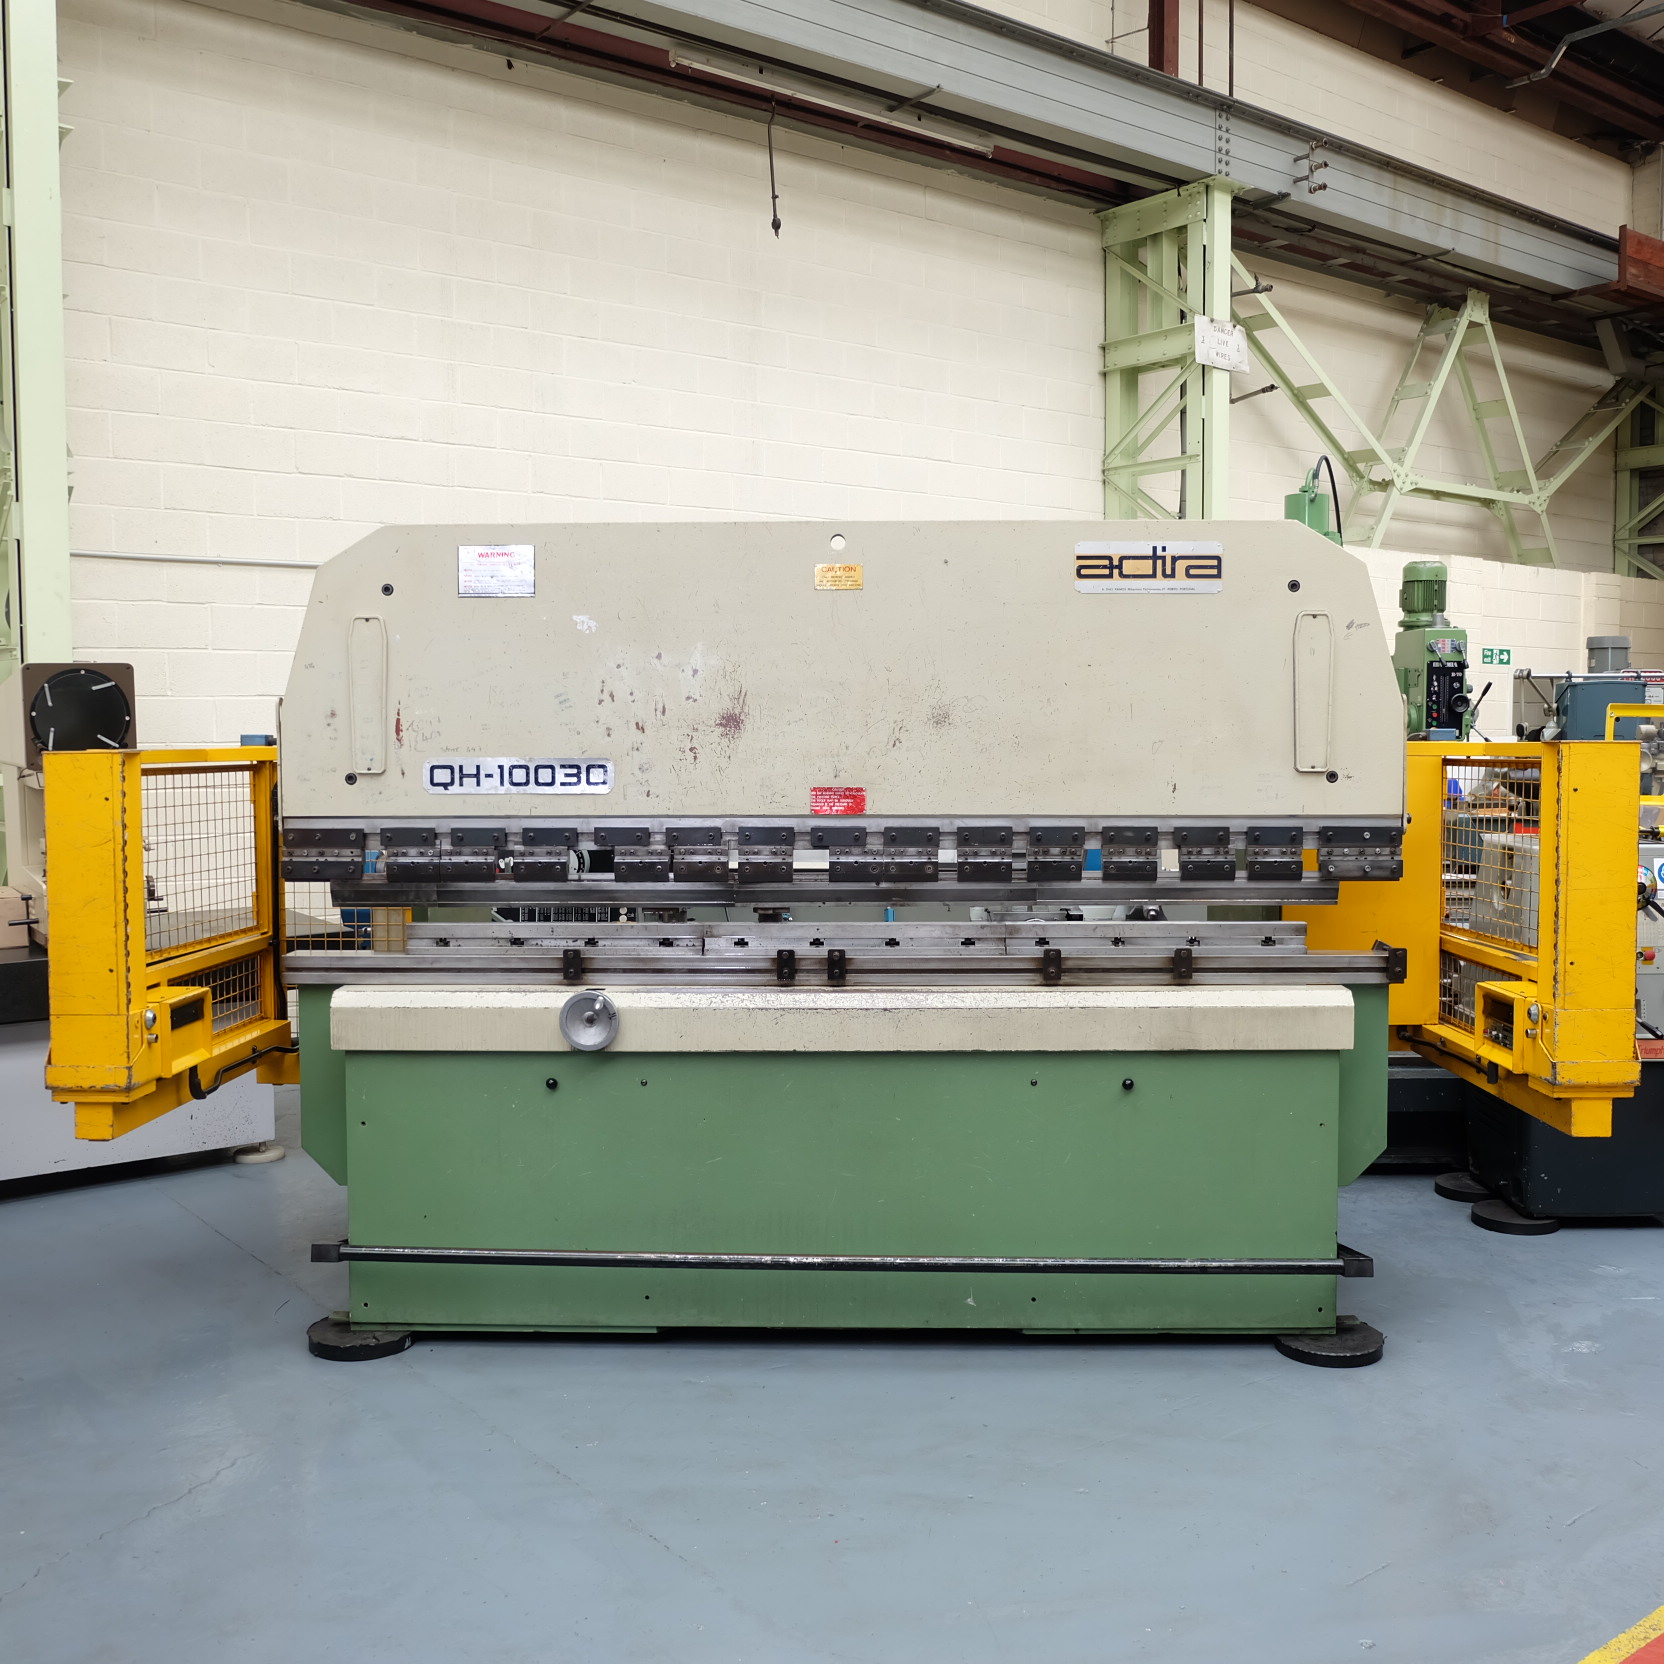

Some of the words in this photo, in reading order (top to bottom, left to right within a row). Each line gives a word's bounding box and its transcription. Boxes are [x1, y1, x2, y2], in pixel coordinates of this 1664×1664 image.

[1214, 326, 1234, 336] DANGER
[1217, 338, 1229, 347] LIVE
[1216, 352, 1231, 361] WIRES
[1076, 546, 1222, 579] adira
[429, 764, 608, 791] QH-10030
